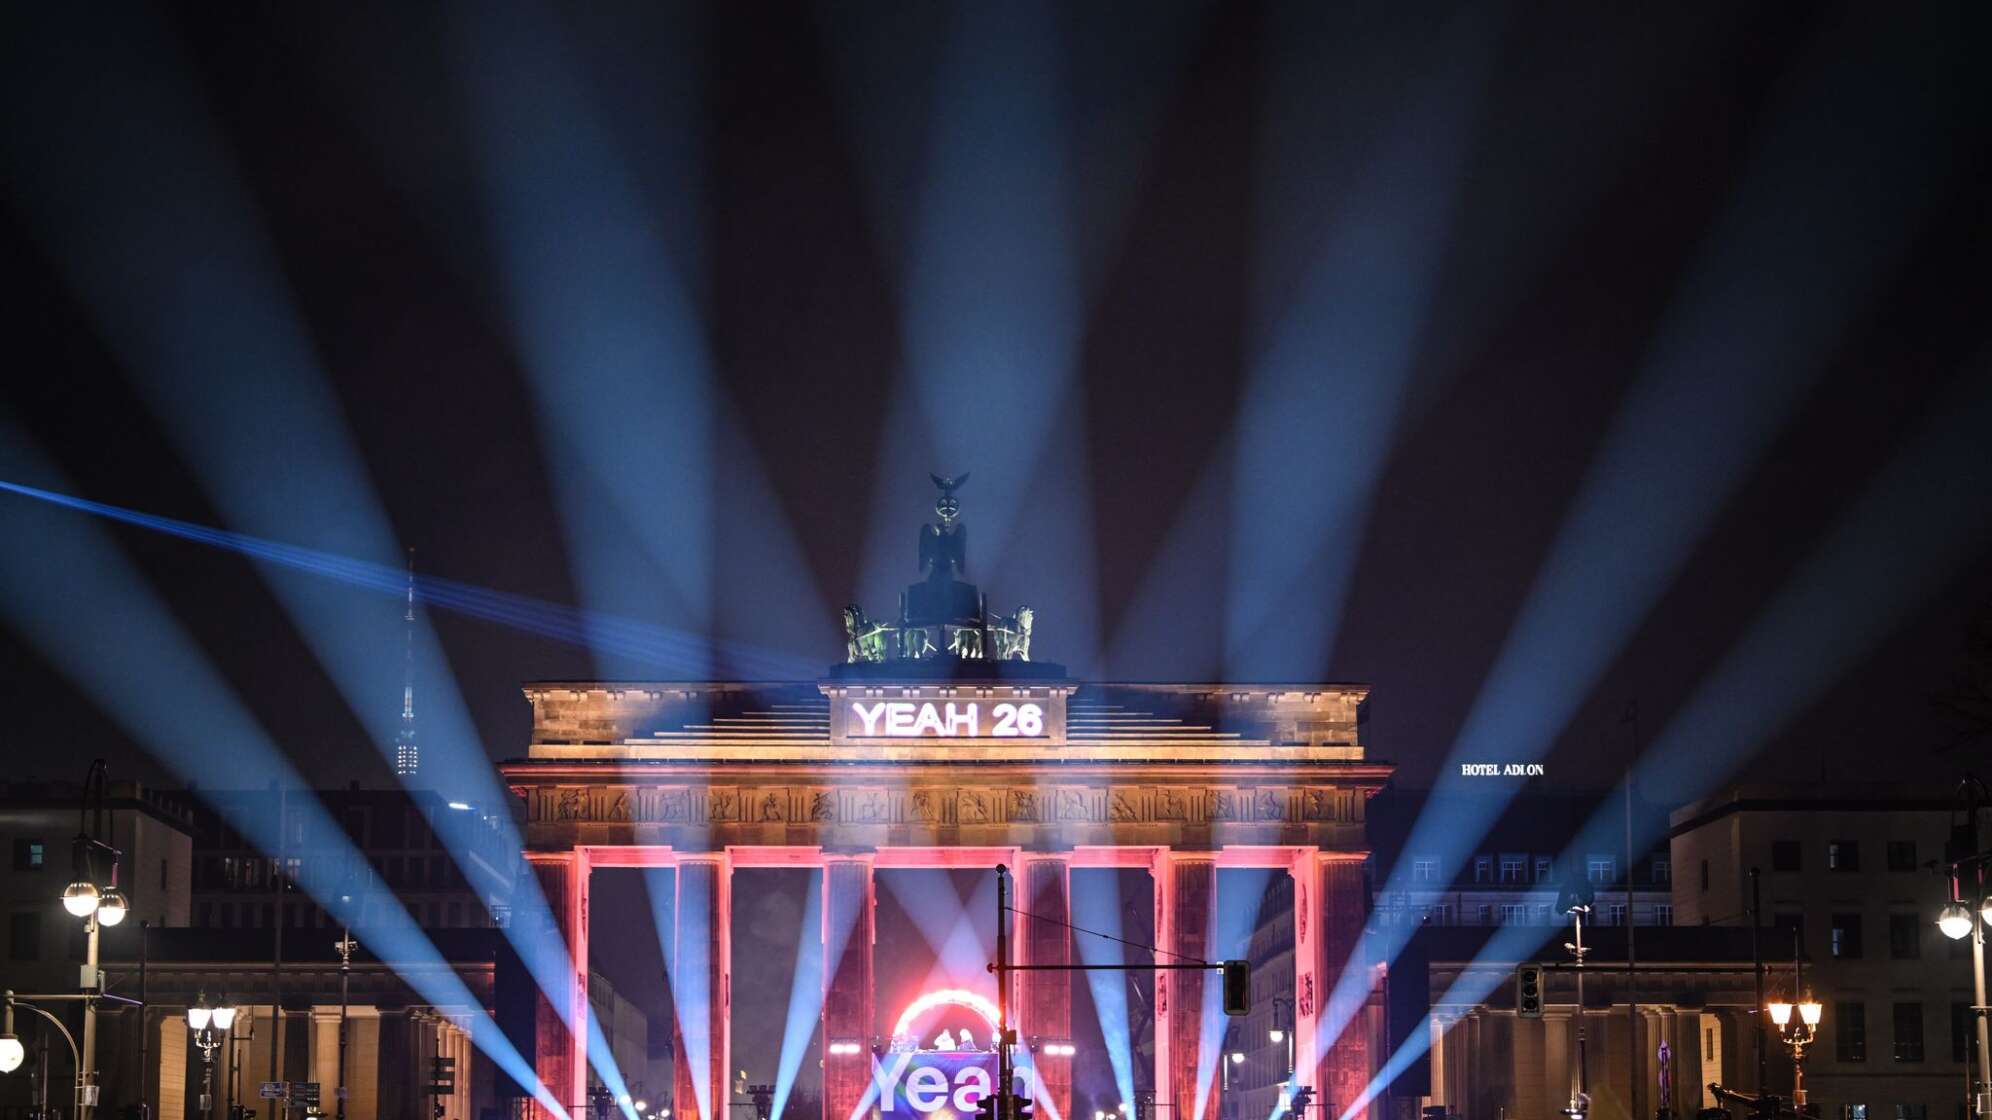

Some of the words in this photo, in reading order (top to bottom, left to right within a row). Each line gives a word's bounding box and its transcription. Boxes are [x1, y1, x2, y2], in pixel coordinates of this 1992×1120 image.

[852, 702, 978, 737] YEAH
[991, 703, 1043, 737] 26
[1461, 764, 1500, 776] HOTEL
[1503, 764, 1544, 776] ADLON
